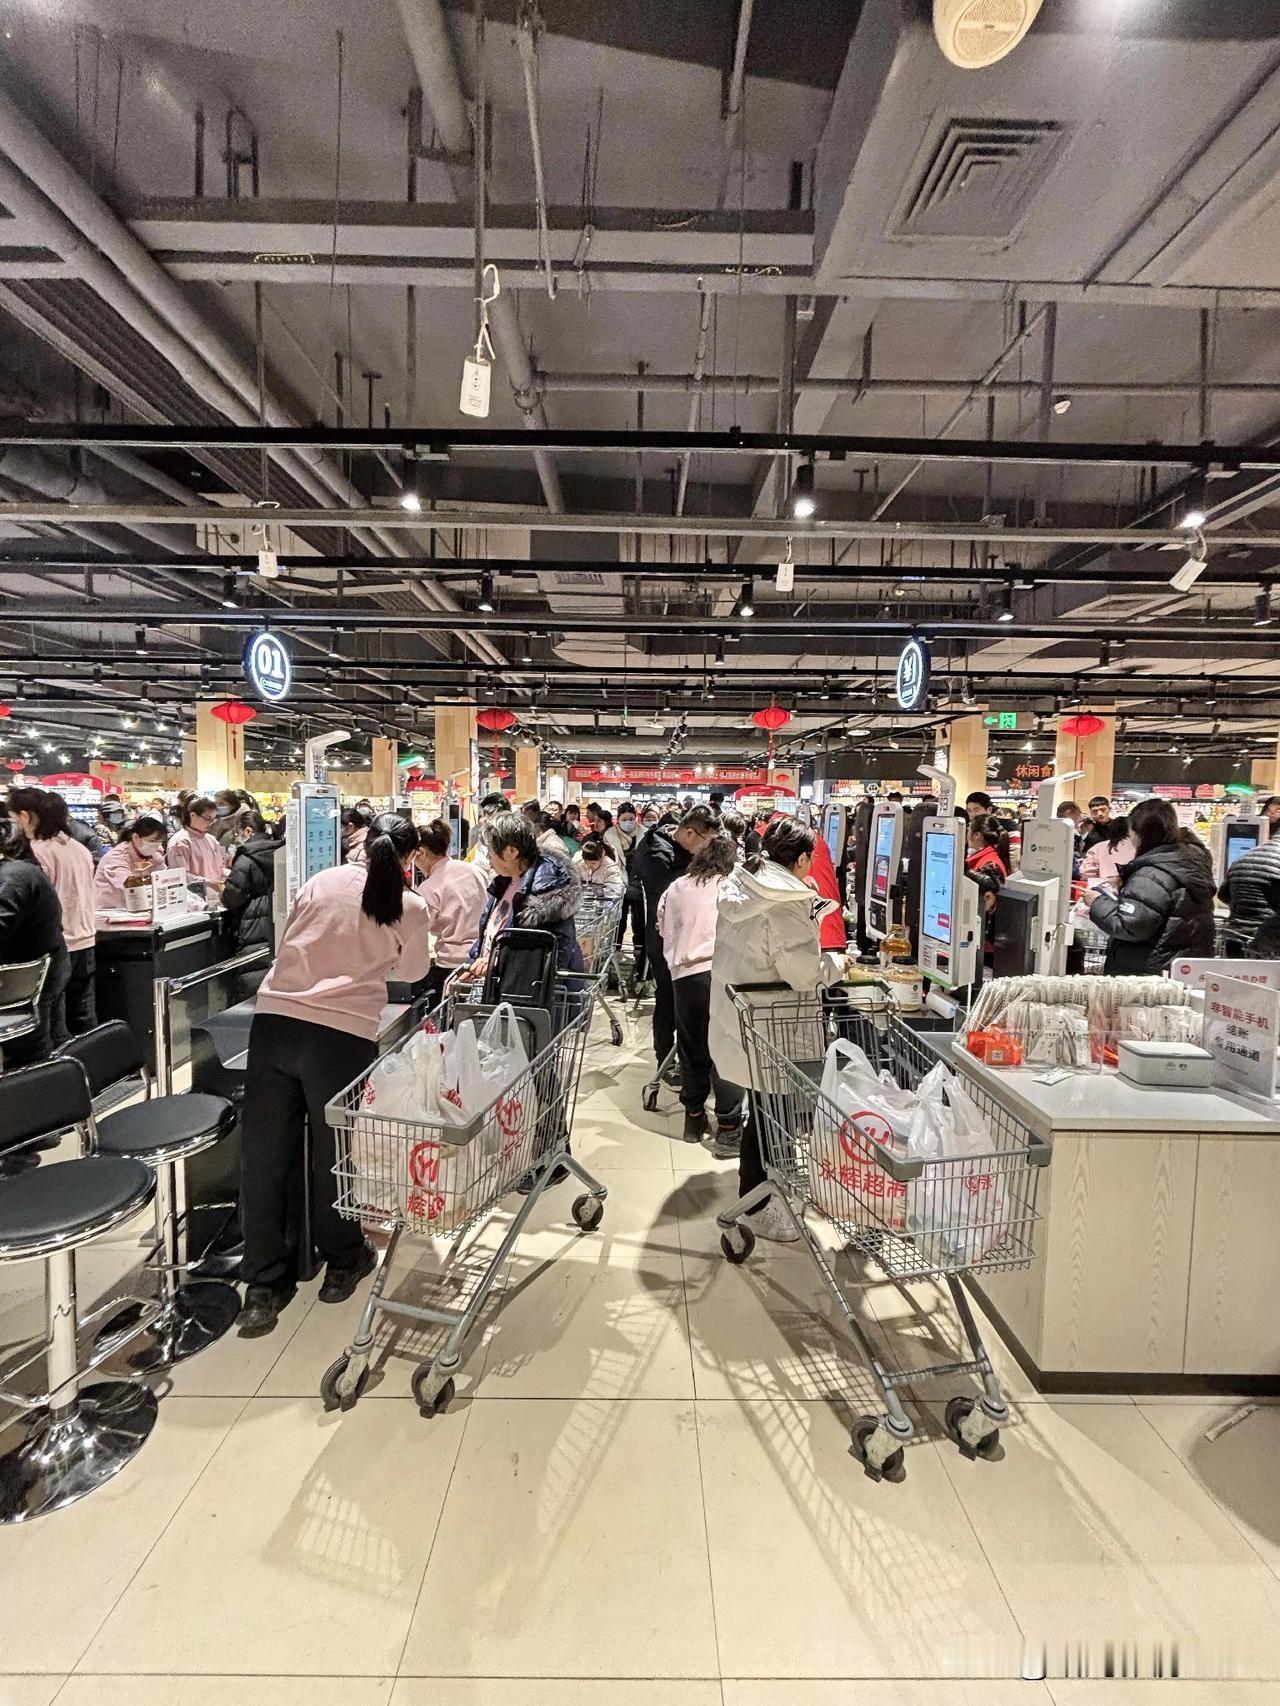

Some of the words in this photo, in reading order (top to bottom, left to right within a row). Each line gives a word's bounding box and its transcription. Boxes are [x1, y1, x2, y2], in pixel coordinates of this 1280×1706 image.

[258, 644, 284, 678] 01
[1015, 764, 1055, 778] 休闲食
[1210, 1001, 1269, 1030] 非智能手机
[1225, 1023, 1250, 1040] 结账
[1214, 1036, 1261, 1062] 专用通道
